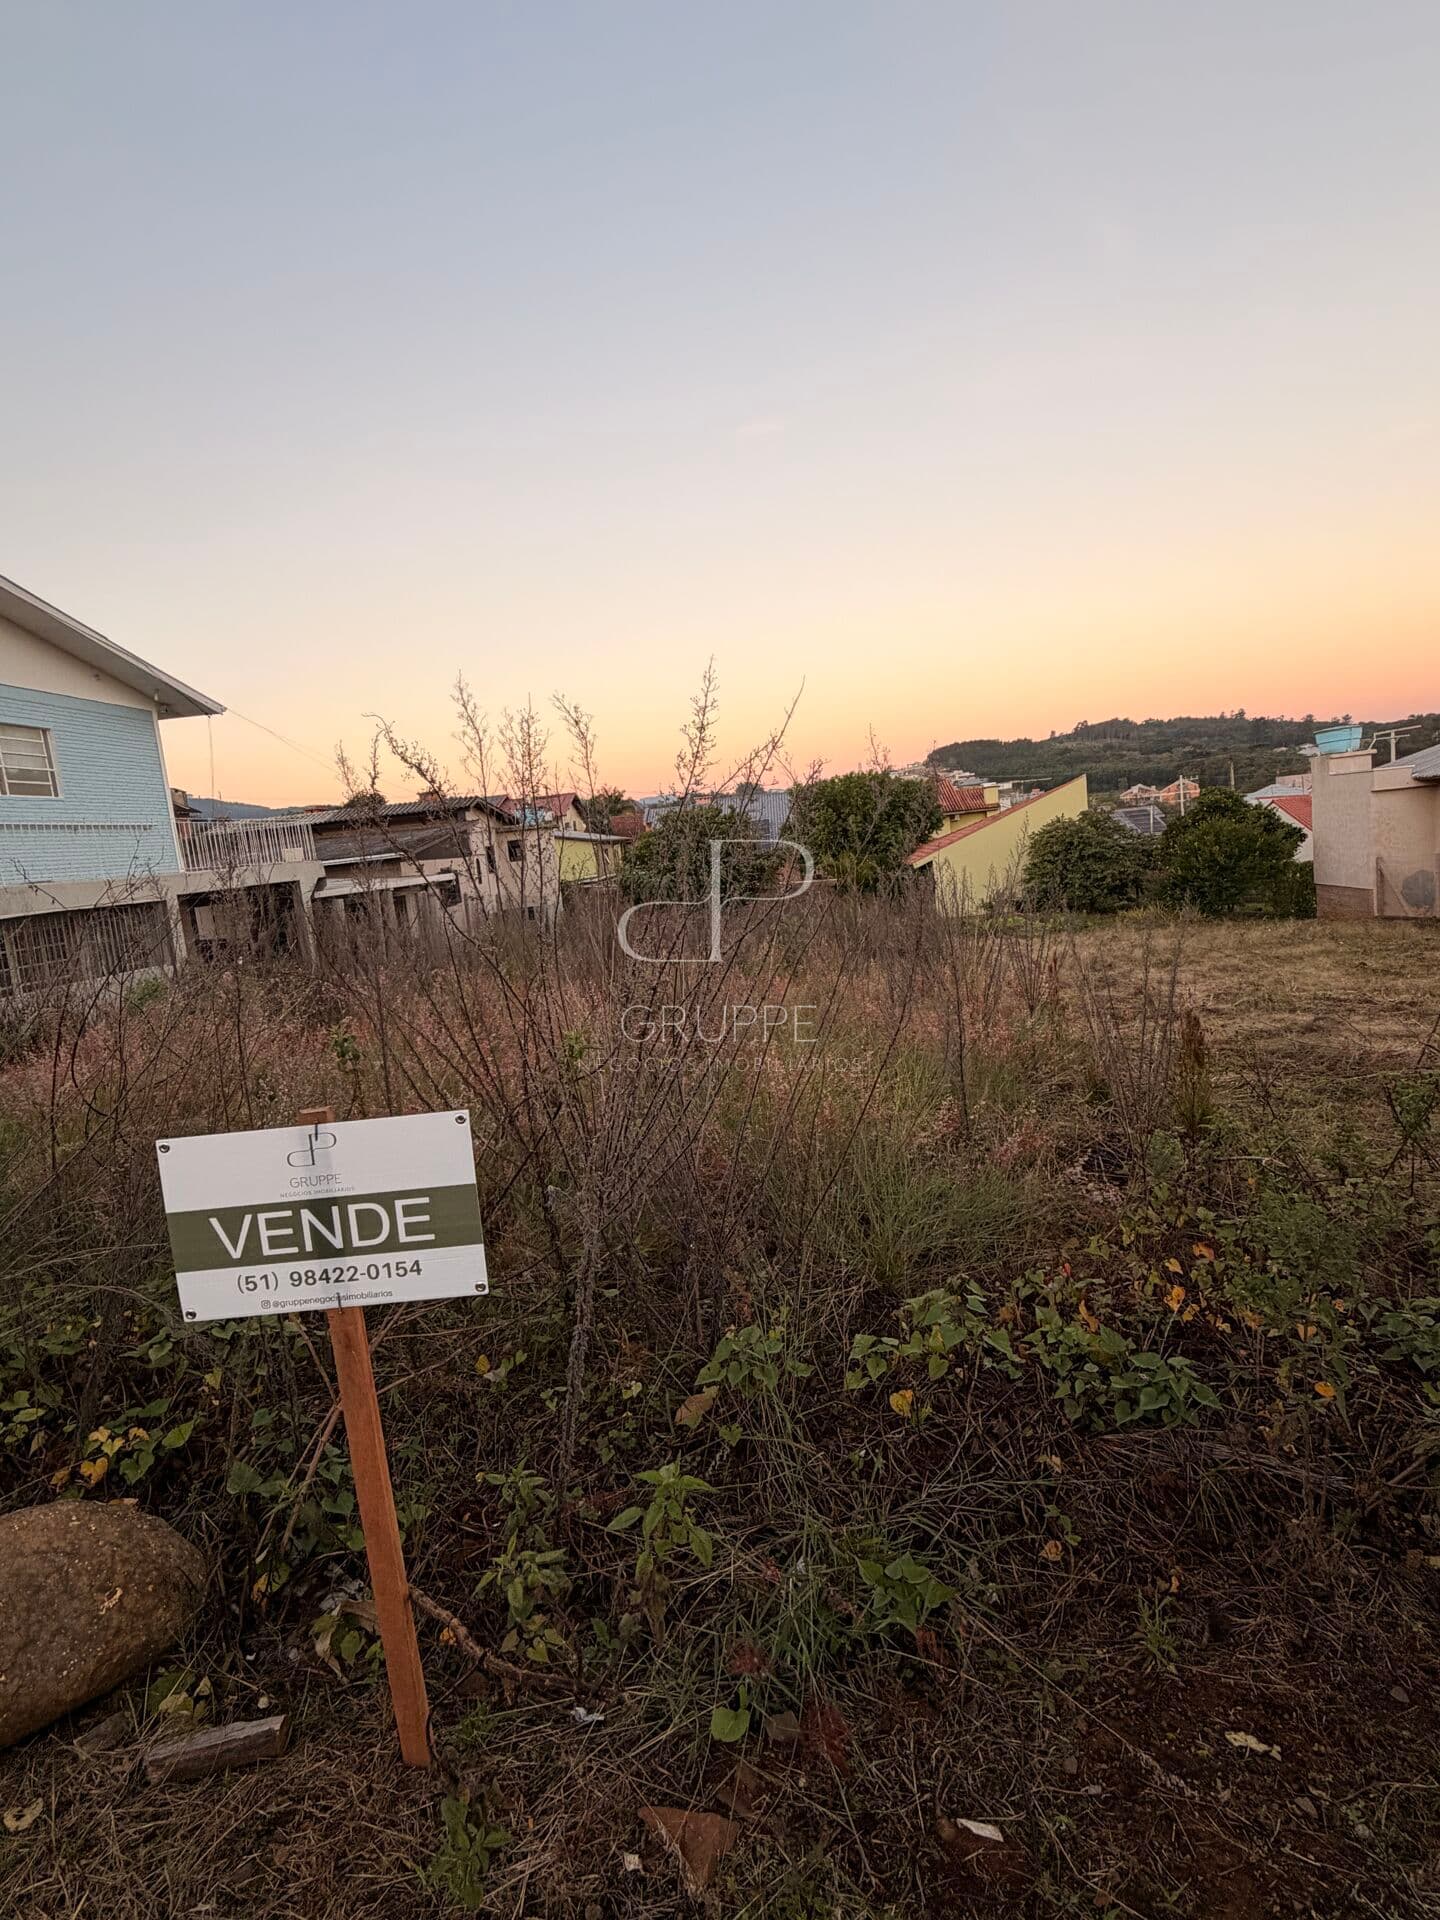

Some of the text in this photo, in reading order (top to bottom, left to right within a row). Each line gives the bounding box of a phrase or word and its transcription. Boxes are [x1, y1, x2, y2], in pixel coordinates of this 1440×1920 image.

[289, 1173, 342, 1189] GRUPPE
[209, 1196, 436, 1259] VENDE
[236, 1259, 423, 1294] (51) 98422-0154
